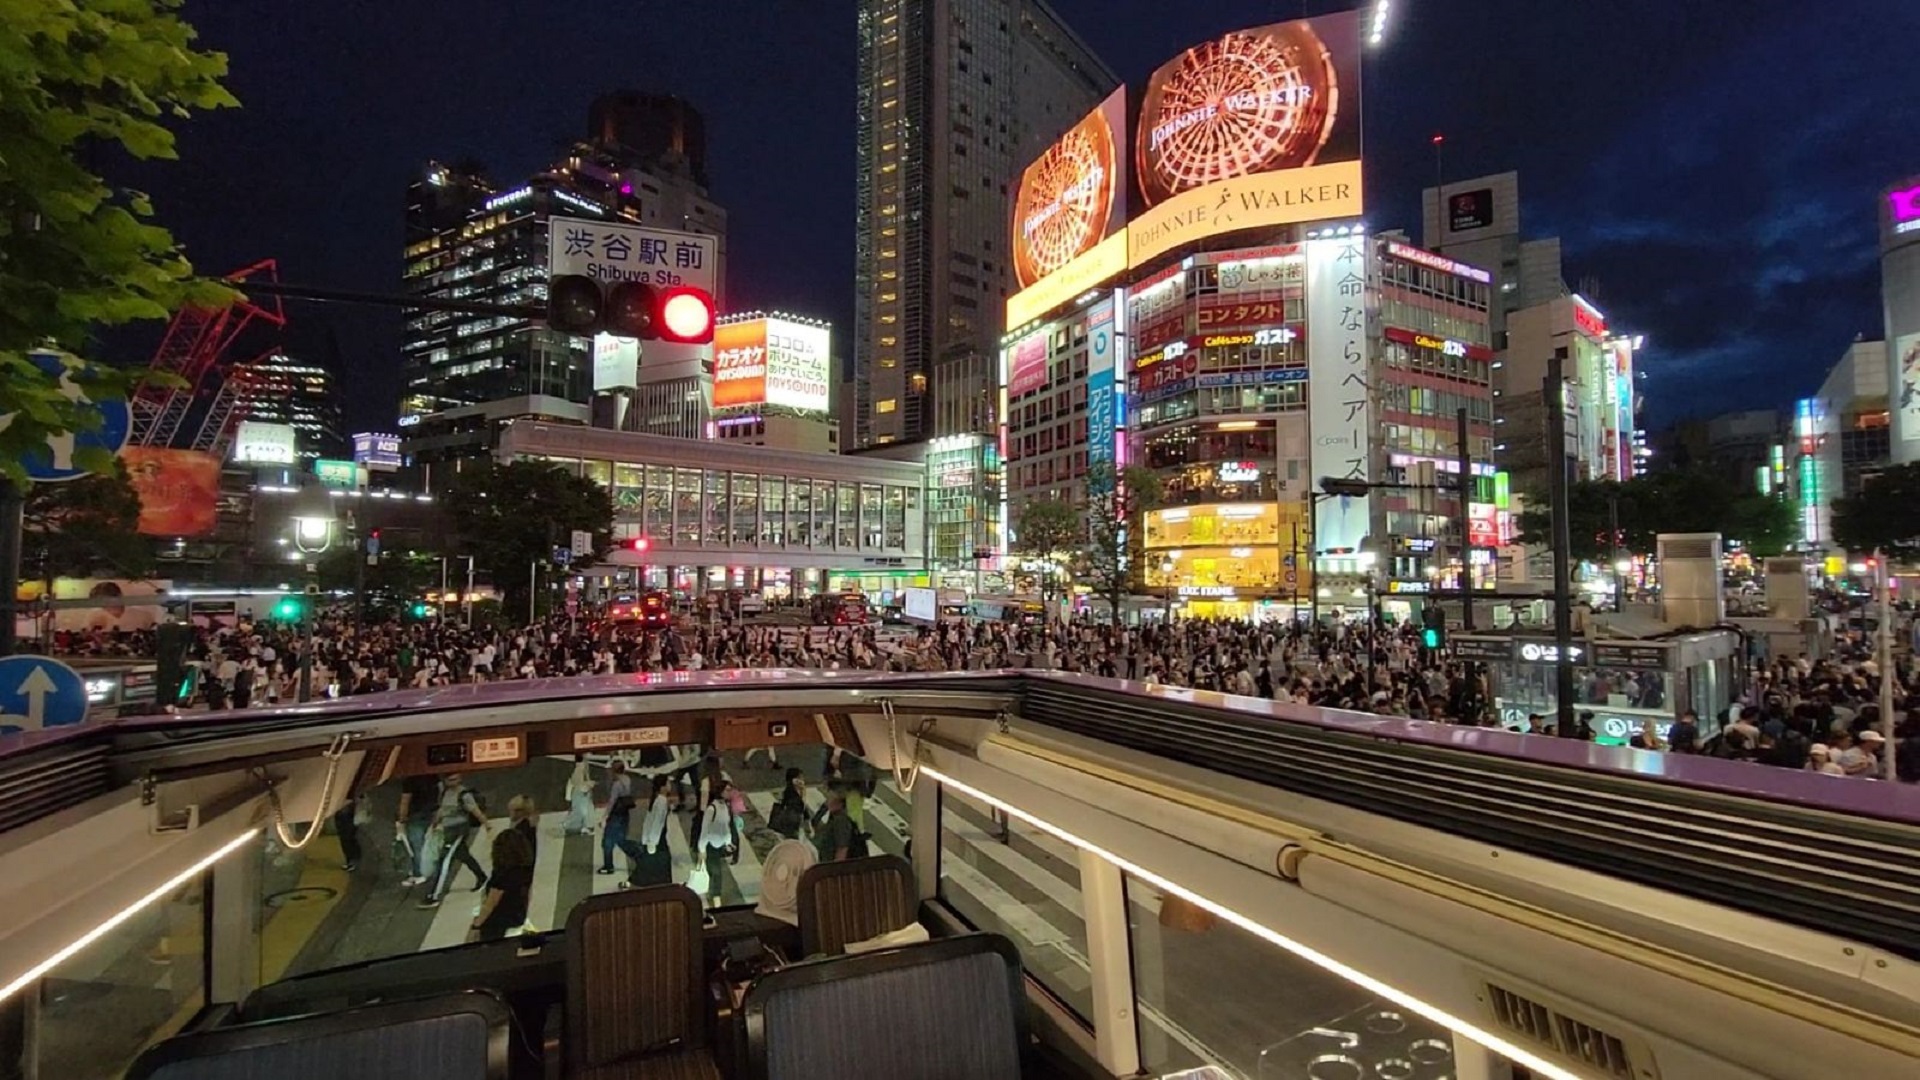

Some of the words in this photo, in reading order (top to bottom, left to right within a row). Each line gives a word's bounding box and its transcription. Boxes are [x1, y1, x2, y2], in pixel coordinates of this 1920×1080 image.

[1150, 105, 1219, 151] JOHNNIE
[1223, 85, 1312, 110] WALKER
[1133, 206, 1207, 257] JOHNNIE
[1240, 183, 1350, 211] WALKER
[565, 227, 703, 270] 渋谷駅前
[587, 262, 650, 283] Shibuya
[655, 269, 687, 287] Sta.
[1200, 303, 1281, 324] コンタクト
[1254, 328, 1296, 345] ガスト
[718, 346, 765, 368] カラオケ
[768, 377, 827, 396] JOYSOUND
